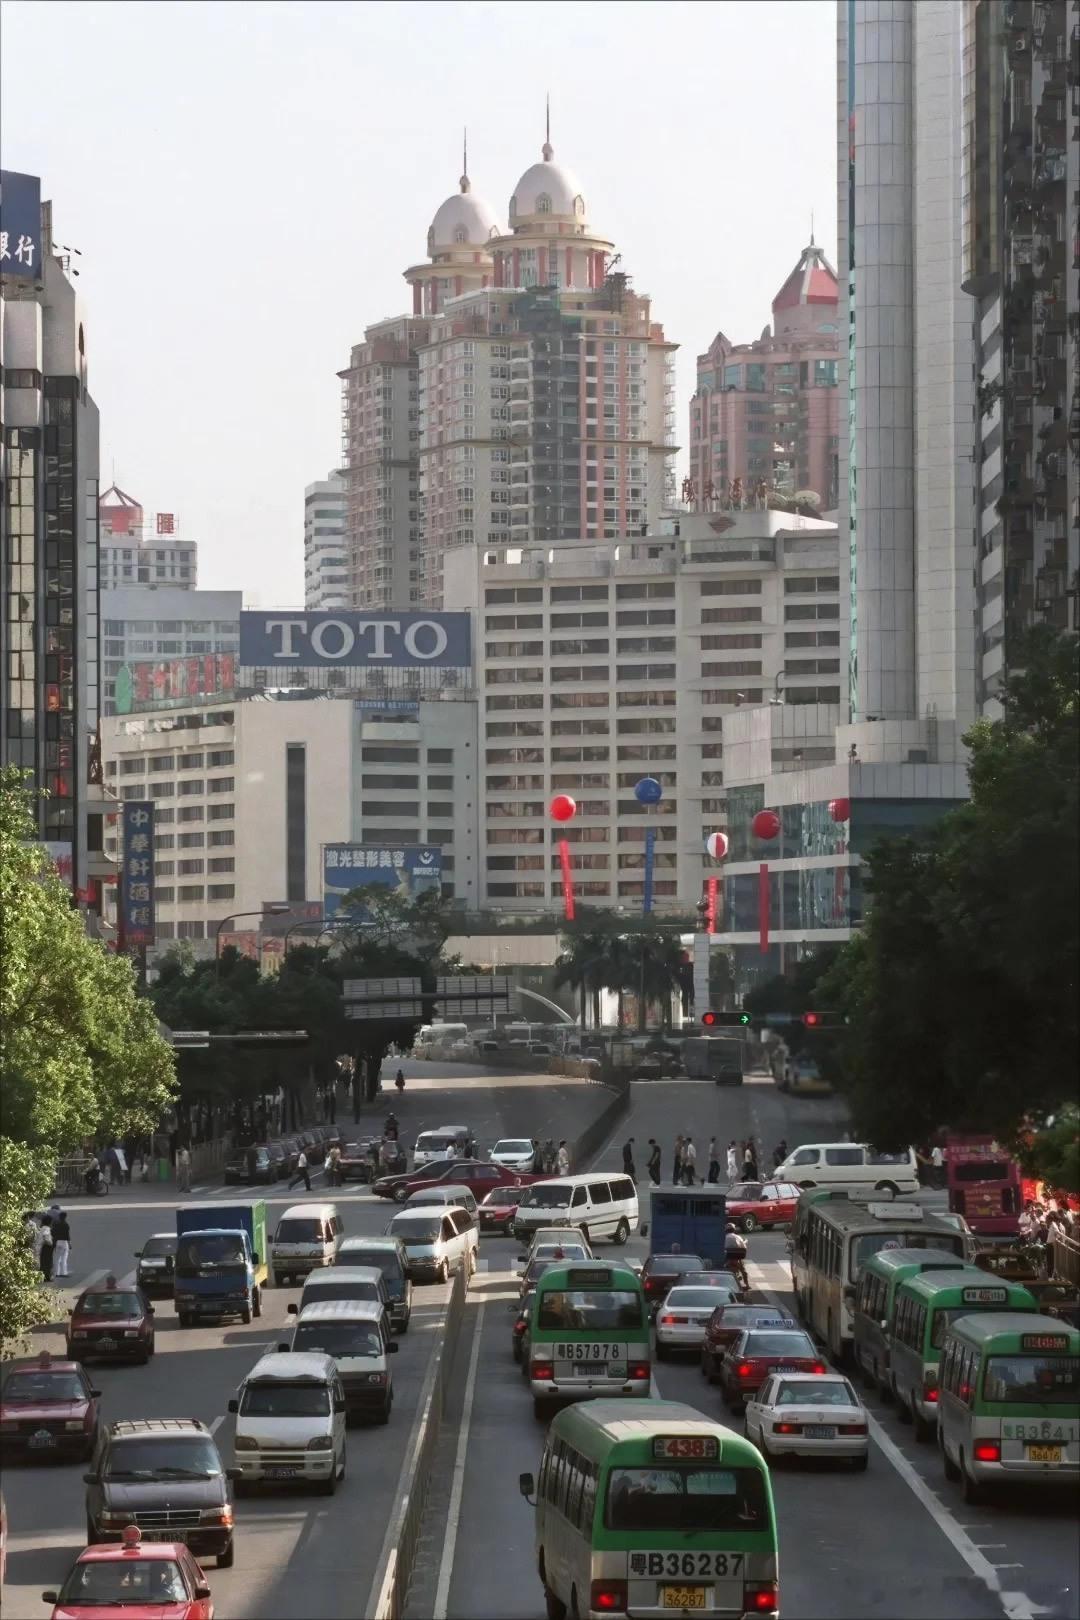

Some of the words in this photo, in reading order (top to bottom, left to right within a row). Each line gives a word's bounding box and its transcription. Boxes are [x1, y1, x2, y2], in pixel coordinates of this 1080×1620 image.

[265, 619, 448, 660] TOTO
[666, 1439, 705, 1457] 438
[630, 1552, 745, 1577] 粤B36287
[666, 1594, 704, 1607] 36287
